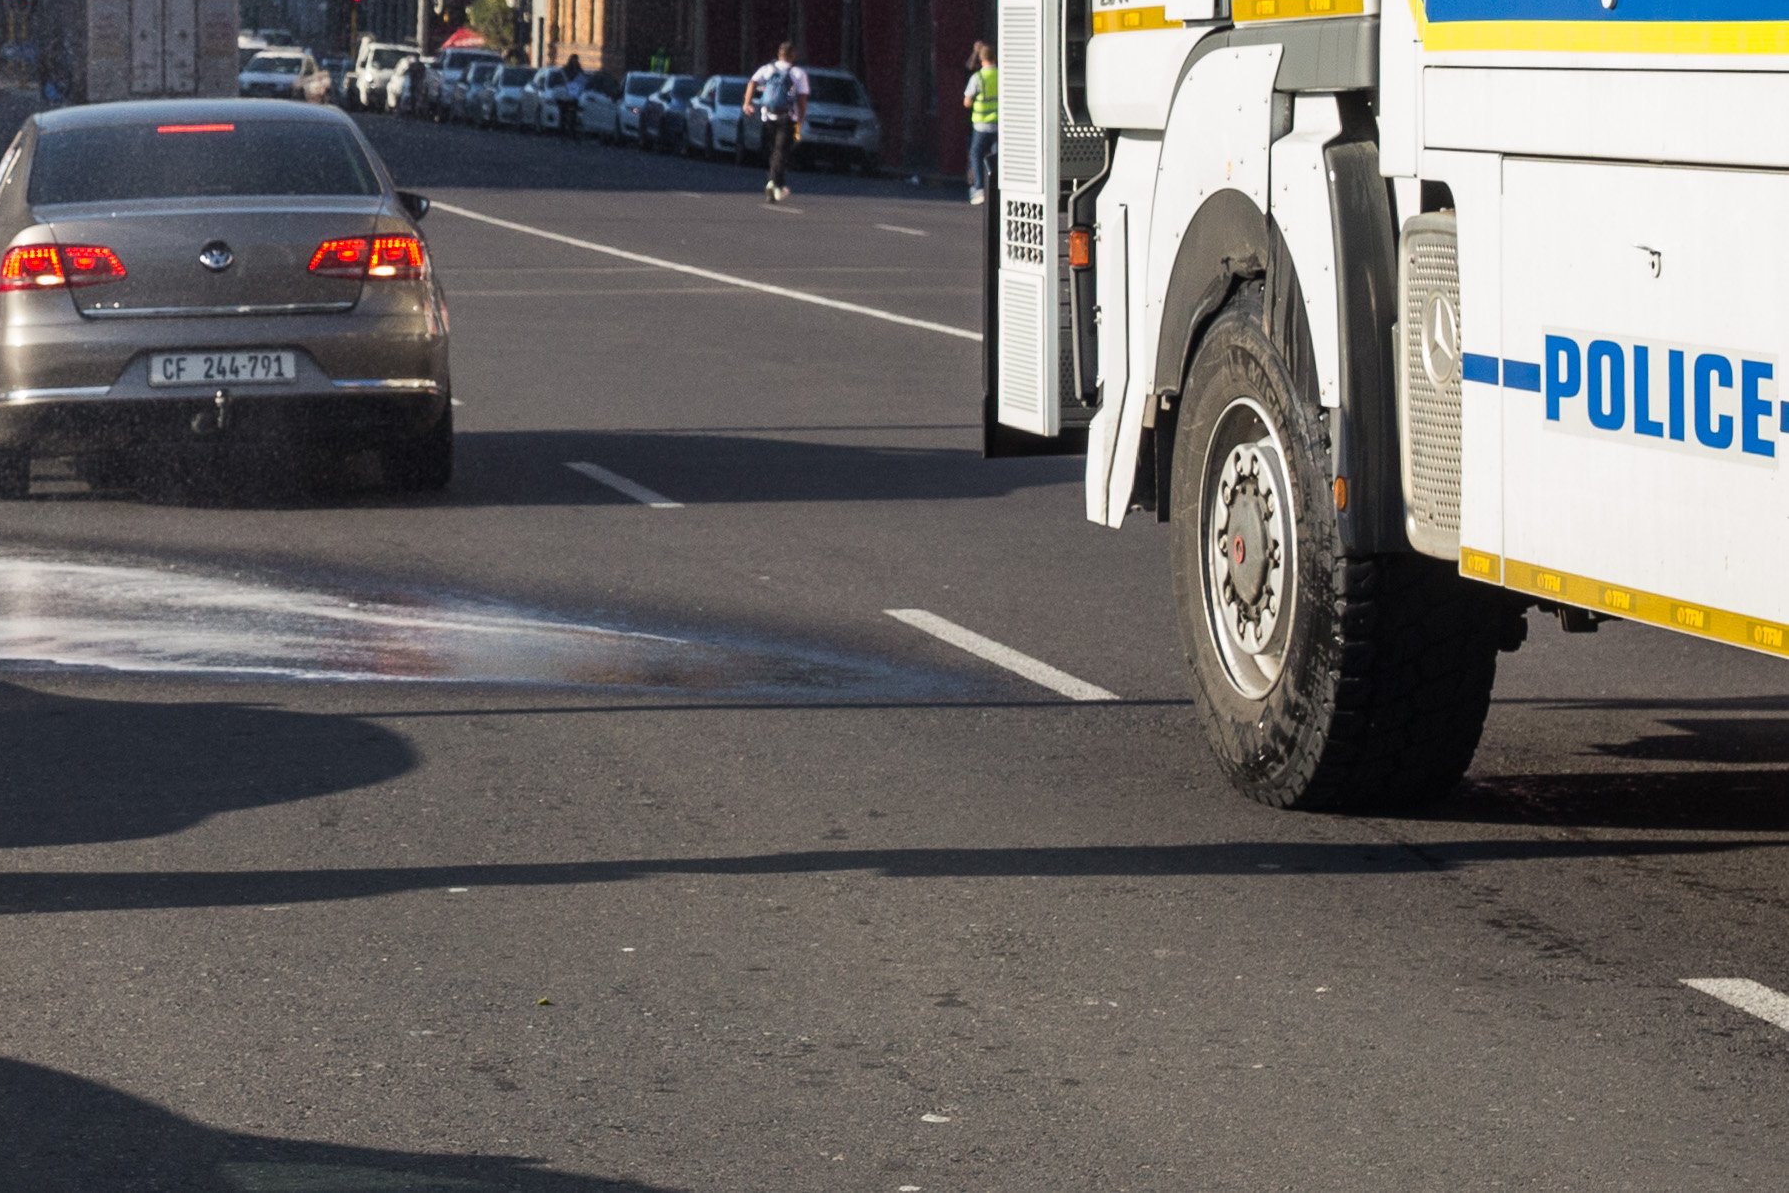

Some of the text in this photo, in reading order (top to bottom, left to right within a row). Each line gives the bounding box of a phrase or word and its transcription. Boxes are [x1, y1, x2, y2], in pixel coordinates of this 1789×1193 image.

[162, 355, 284, 380] CF 244-791
[1545, 334, 1775, 458] POLICE
